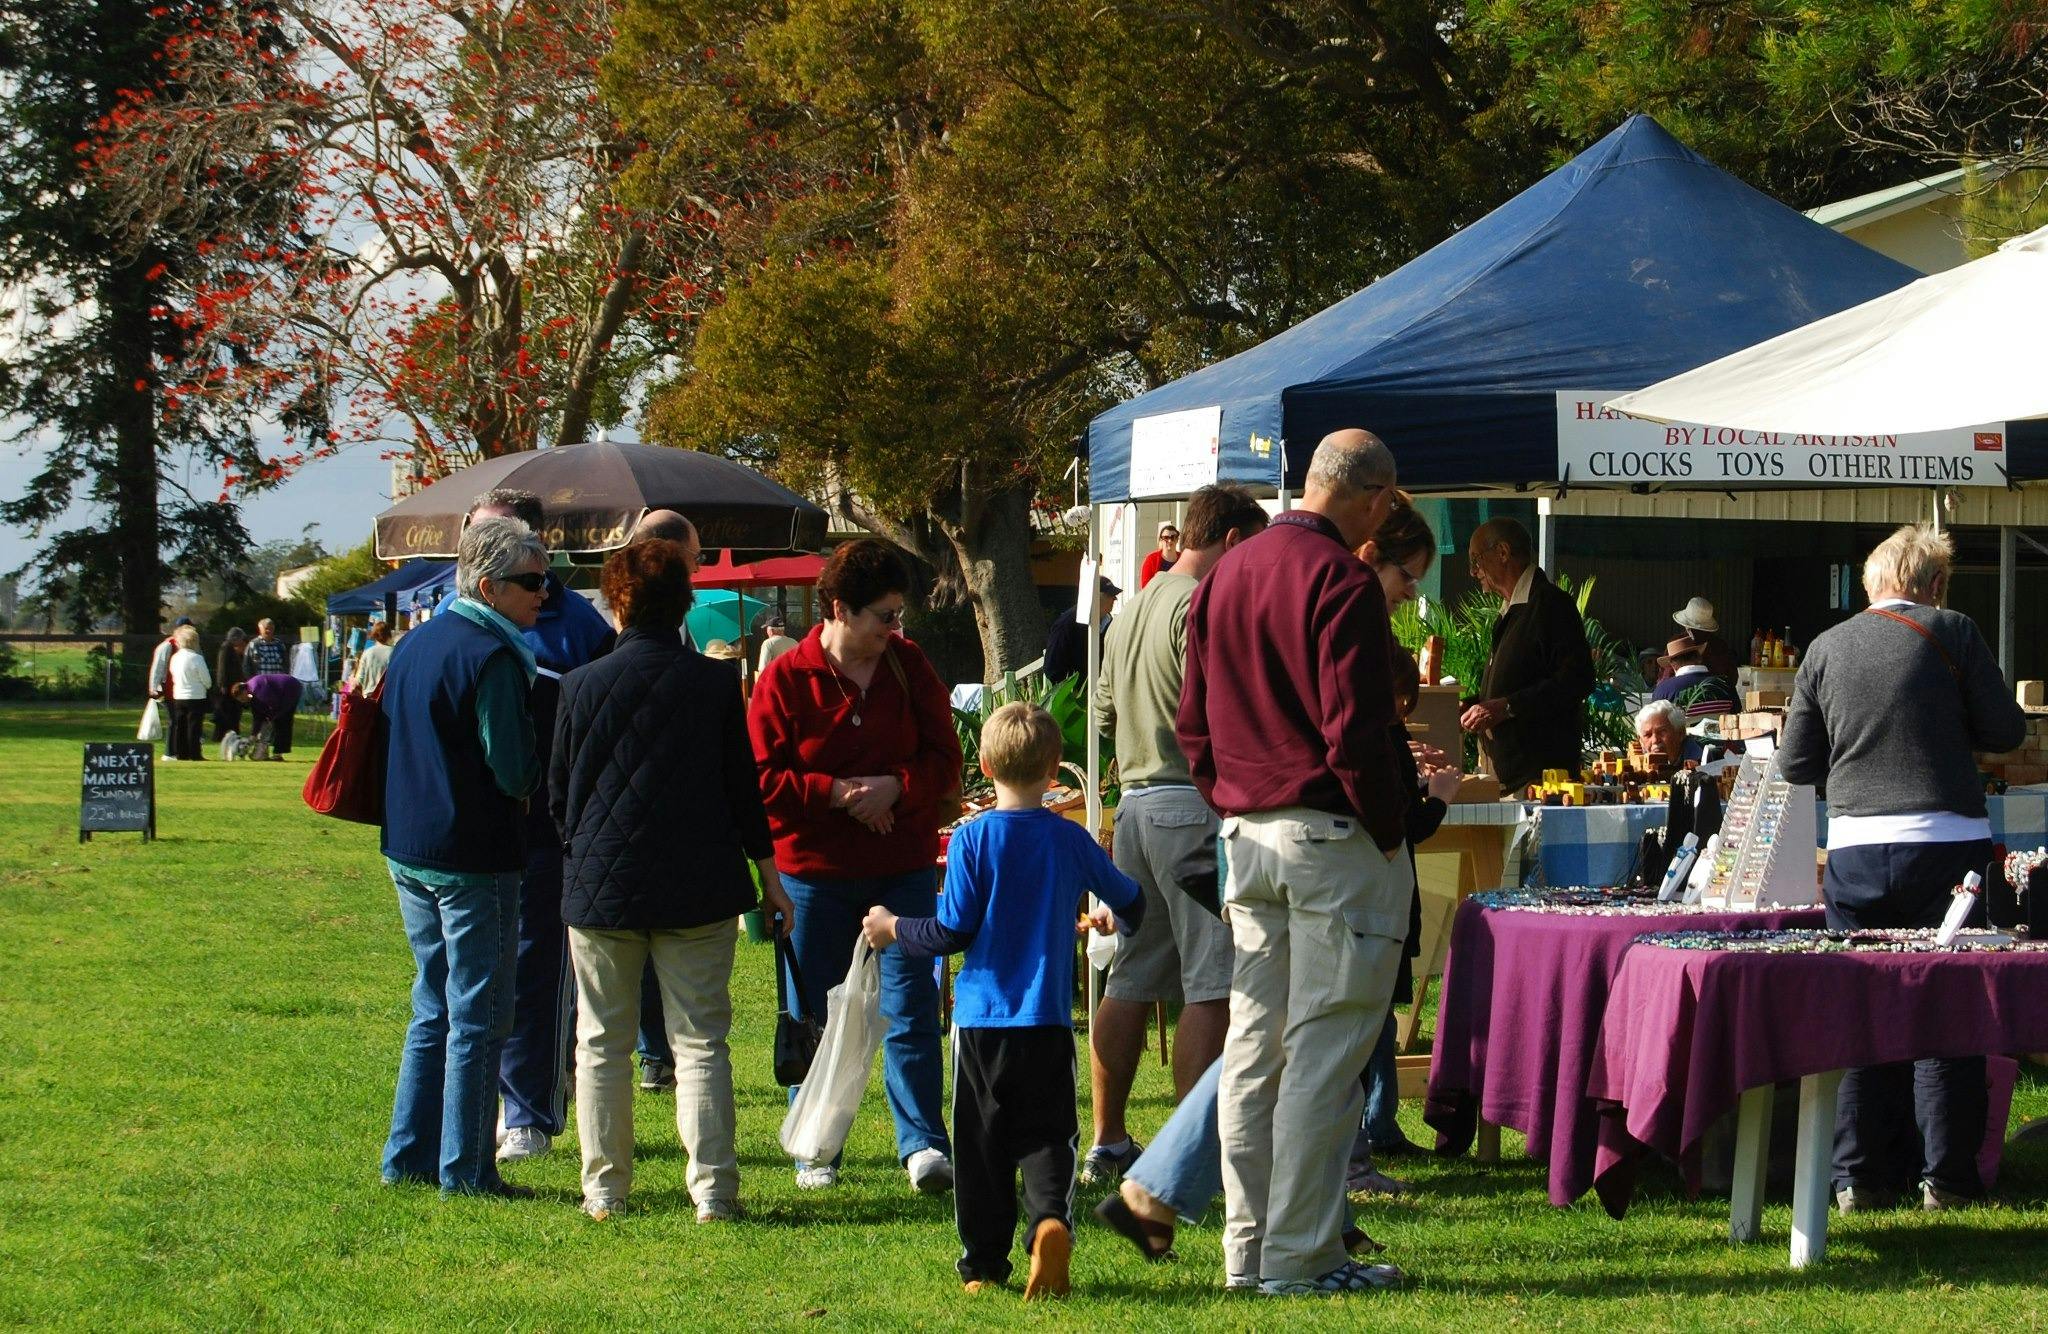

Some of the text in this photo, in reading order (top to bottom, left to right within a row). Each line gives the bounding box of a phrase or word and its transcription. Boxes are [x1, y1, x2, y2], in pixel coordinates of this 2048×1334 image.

[1664, 427, 1697, 446] BY
[1701, 427, 1786, 446] LOCAL
[1589, 451, 1974, 481] CLOCKS TOYS OTHER ITEMS
[405, 525, 444, 548] Coffee
[542, 526, 625, 544] ONICUS
[98, 755, 140, 767] NEXT
[83, 772, 148, 786] MARKET
